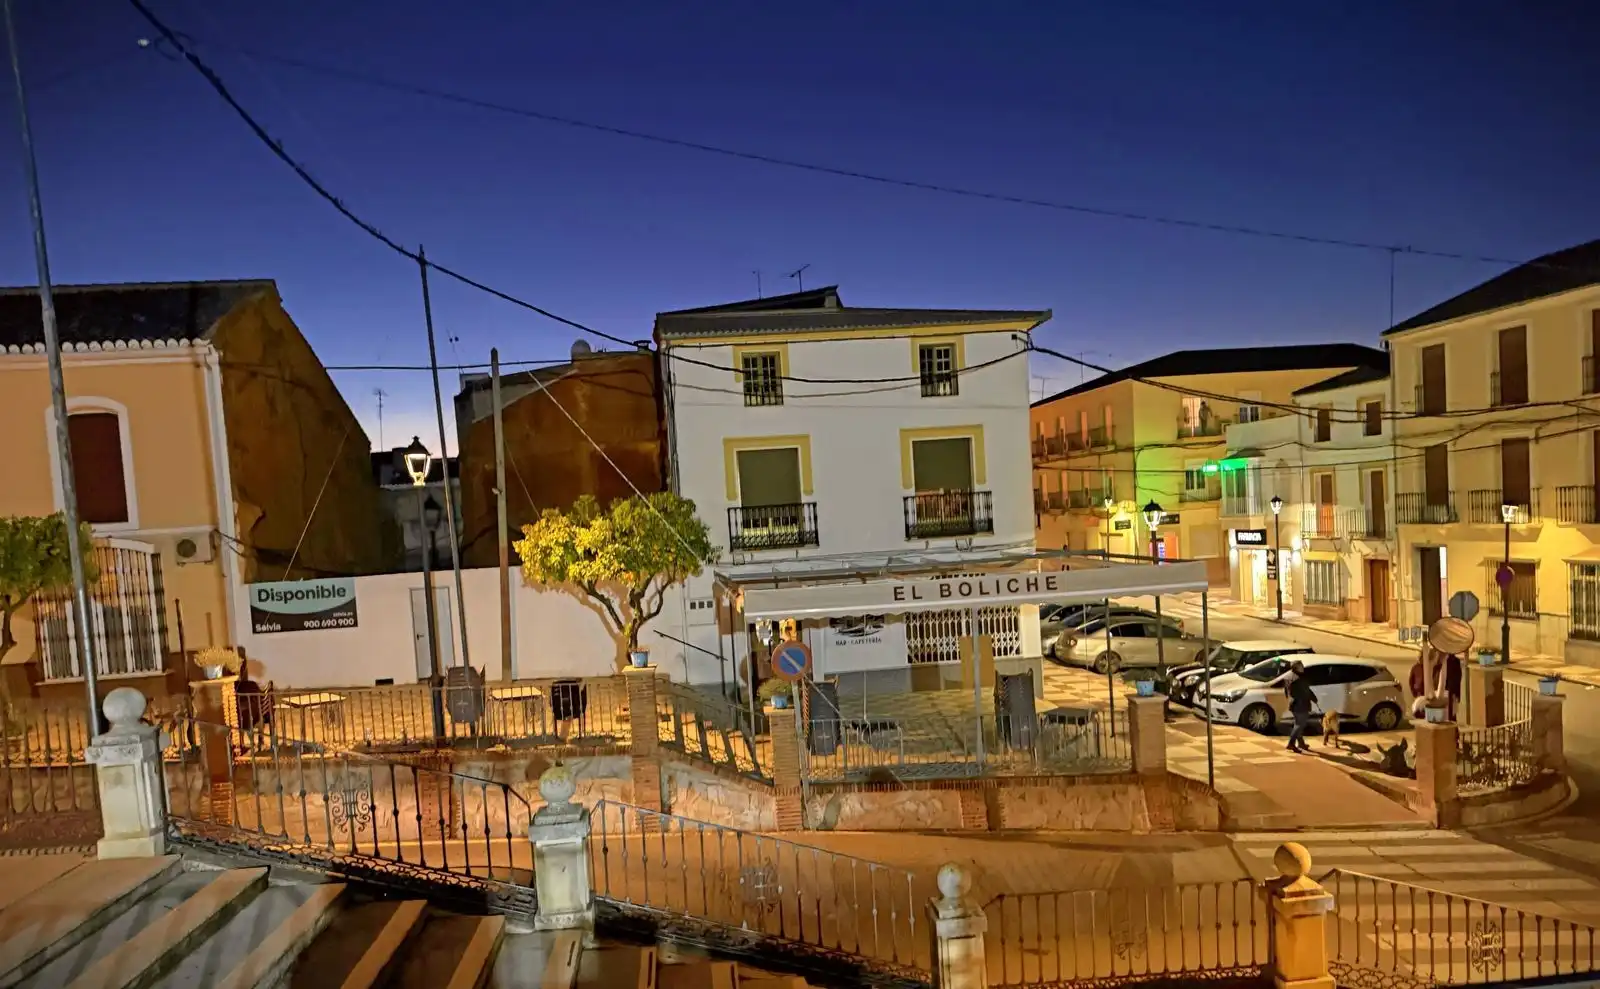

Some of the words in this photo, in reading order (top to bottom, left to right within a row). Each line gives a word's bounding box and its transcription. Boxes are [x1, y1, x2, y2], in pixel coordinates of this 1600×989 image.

[257, 584, 347, 604] Disponible
[893, 585, 923, 601] EL
[939, 575, 1058, 598] BOLICHE
[303, 620, 320, 628] 900
[321, 619, 337, 627] 690
[338, 617, 355, 626] 900
